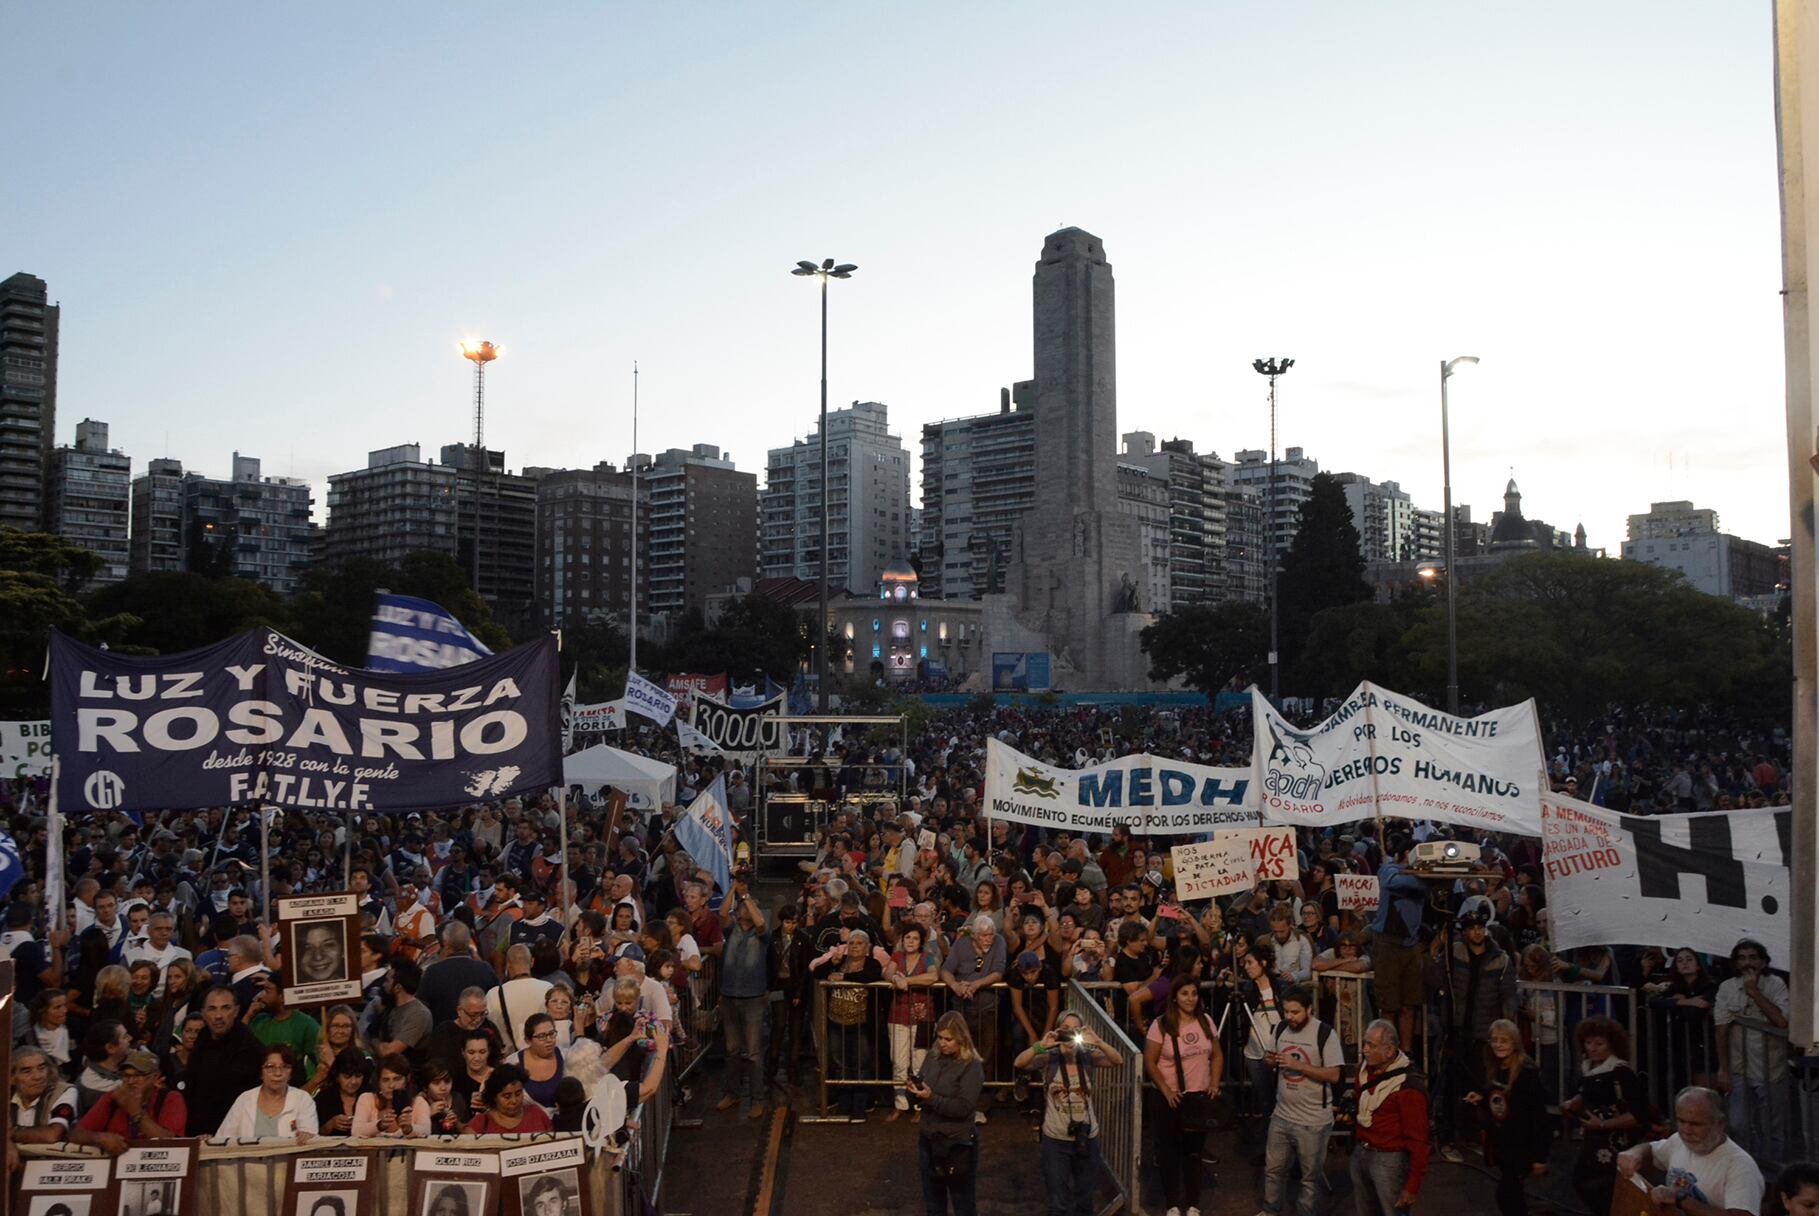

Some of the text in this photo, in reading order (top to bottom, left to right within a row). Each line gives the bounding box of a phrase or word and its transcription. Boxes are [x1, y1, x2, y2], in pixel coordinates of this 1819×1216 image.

[80, 664, 522, 714] LUZ Y FUERZA
[669, 679, 707, 690] AMSAFE
[627, 687, 670, 714] ROSARIO
[77, 700, 528, 760] ROSARIO
[698, 704, 777, 747] 30000
[1384, 700, 1499, 737] PERMANENTE
[1353, 723, 1421, 748] POR LOS
[202, 748, 401, 784] desde 1928 con la gente
[1414, 760, 1521, 798] HUMANOS
[1078, 768, 1250, 808] MEDH
[993, 798, 1067, 822] MOVIMIENTO
[1071, 813, 1142, 828] ECUMÉNICO
[1145, 814, 1169, 828] POR
[1172, 814, 1190, 827] LOS
[1193, 811, 1245, 825] DERECHOS
[1262, 792, 1324, 813] ROSARIO
[1547, 823, 1560, 835] ES
[1566, 823, 1578, 835] UN
[1177, 847, 1198, 856] NOS
[1544, 835, 1614, 857] ARGADA DE
[1195, 862, 1215, 870] PATA
[1546, 848, 1621, 881] FUTURO
[1342, 896, 1380, 906] HAMBRE
[435, 1157, 481, 1166] OLGA RUIZ
